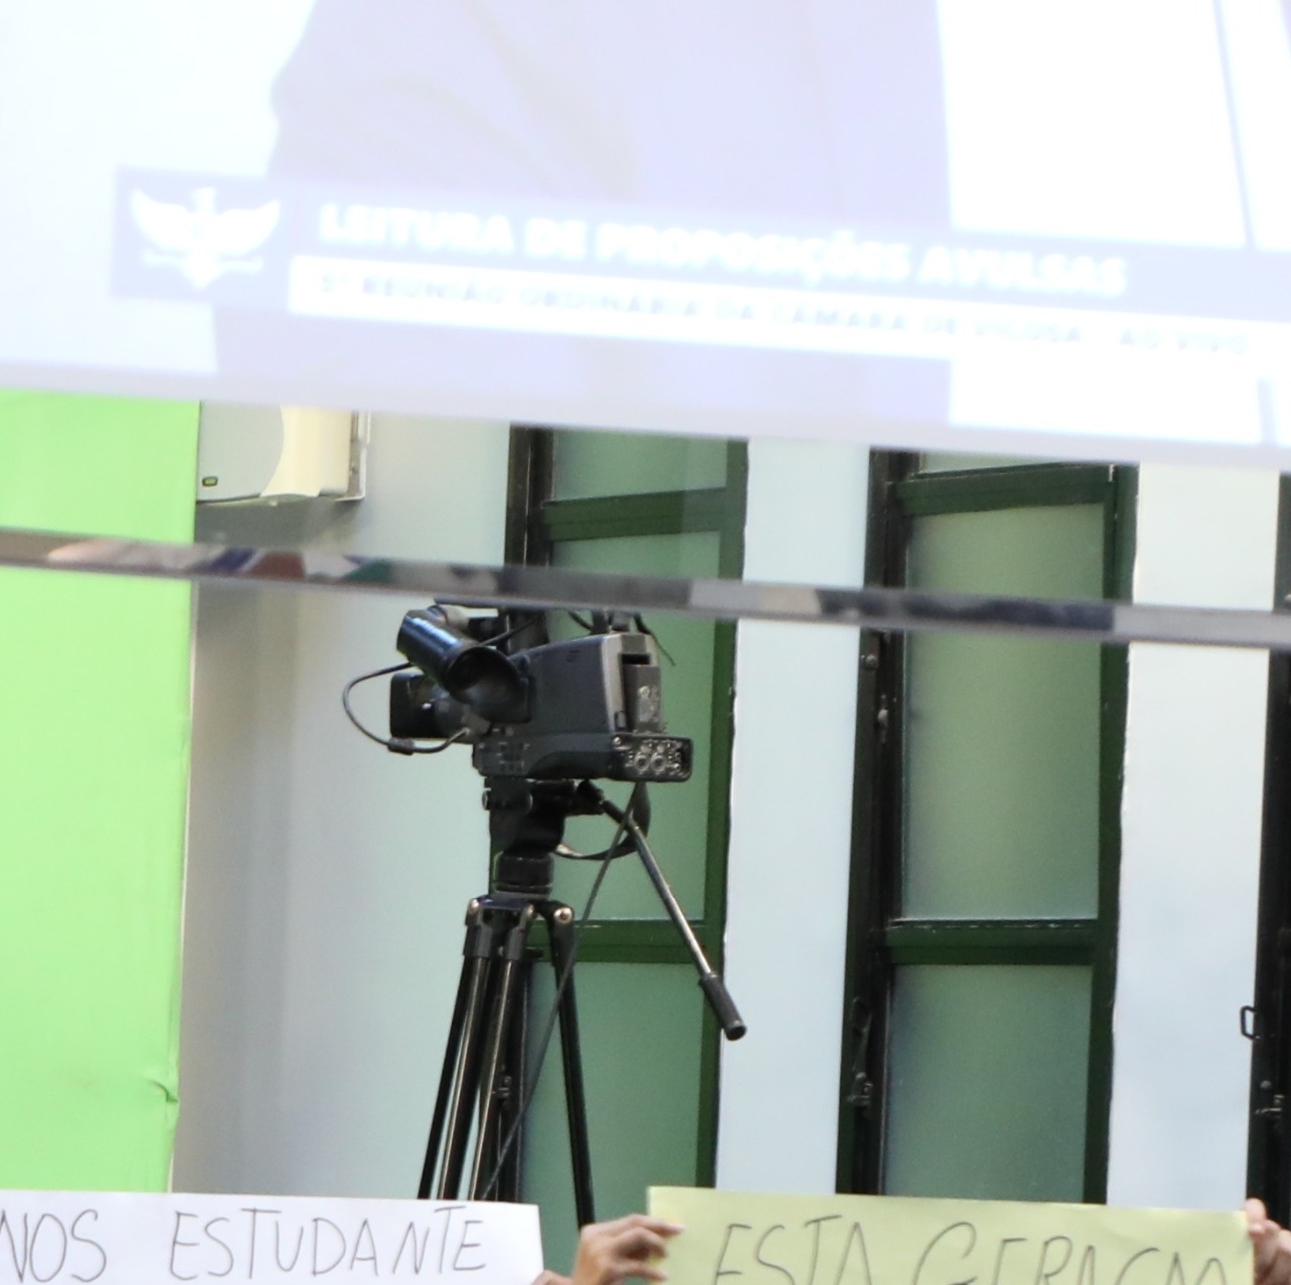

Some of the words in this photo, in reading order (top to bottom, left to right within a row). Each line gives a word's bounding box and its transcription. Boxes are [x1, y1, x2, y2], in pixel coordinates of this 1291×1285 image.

[319, 201, 515, 255] LEITURA
[524, 215, 588, 262] DE
[595, 221, 912, 287] PROPOSIÇÕES
[918, 245, 1128, 298] AVULSAS
[168, 1204, 488, 1281] ESTUDANTE
